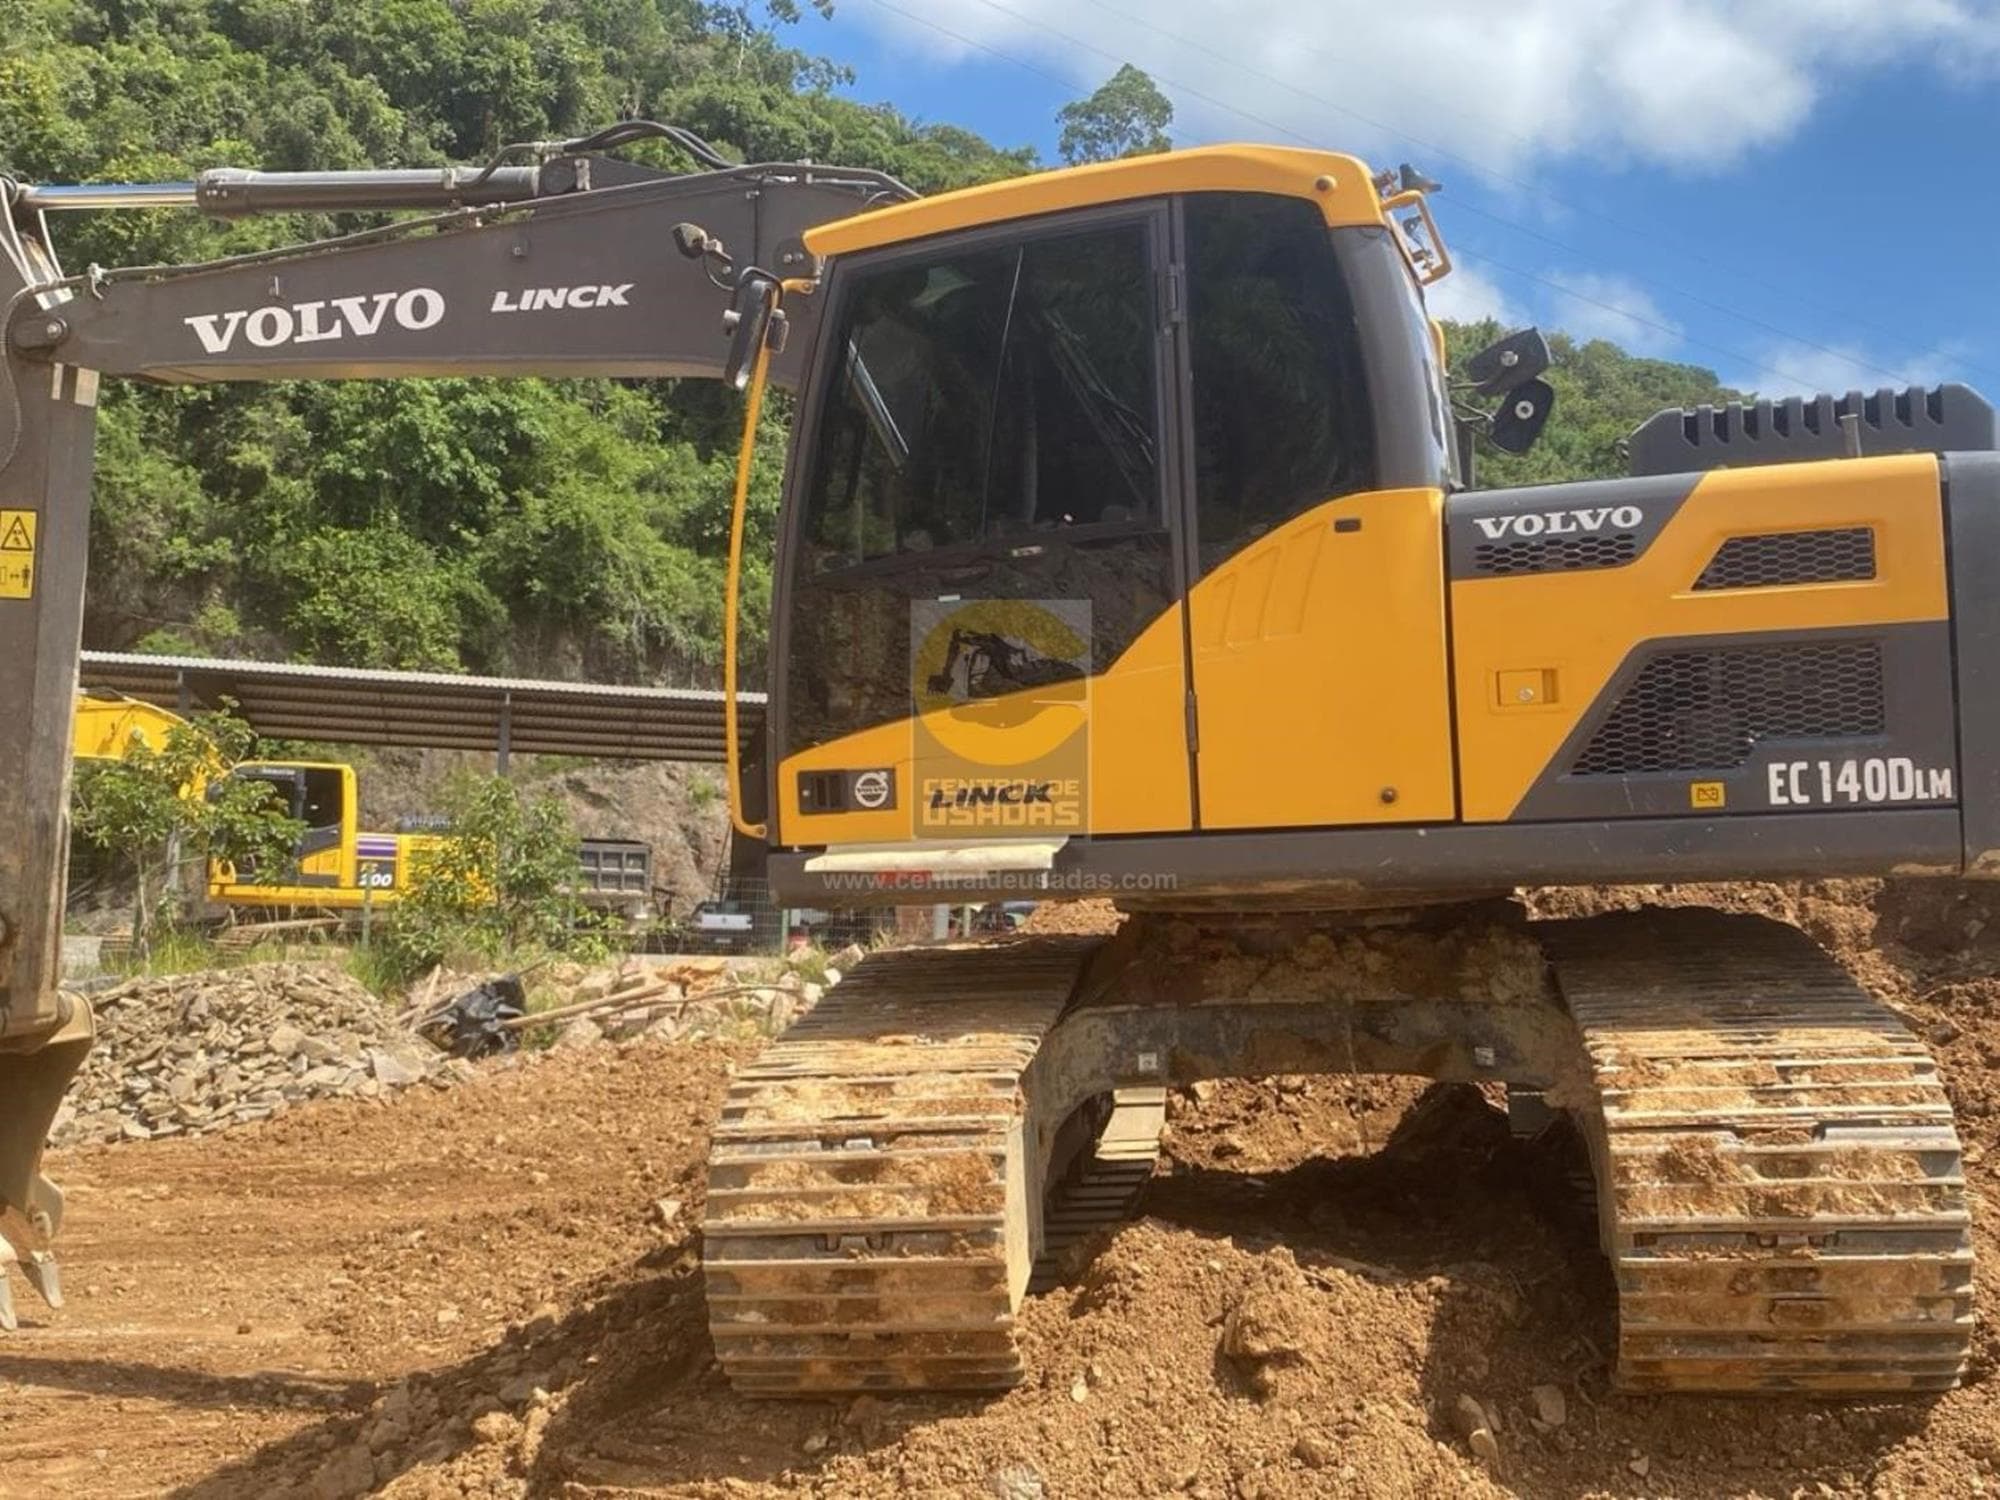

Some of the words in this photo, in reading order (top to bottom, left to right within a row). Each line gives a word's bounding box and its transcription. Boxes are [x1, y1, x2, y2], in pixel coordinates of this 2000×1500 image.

[490, 283, 635, 313] LINCK
[184, 287, 446, 354] VOLVO
[1473, 505, 1643, 539] VOLVO
[930, 783, 1056, 809] LINCK
[1767, 760, 1810, 805] EC
